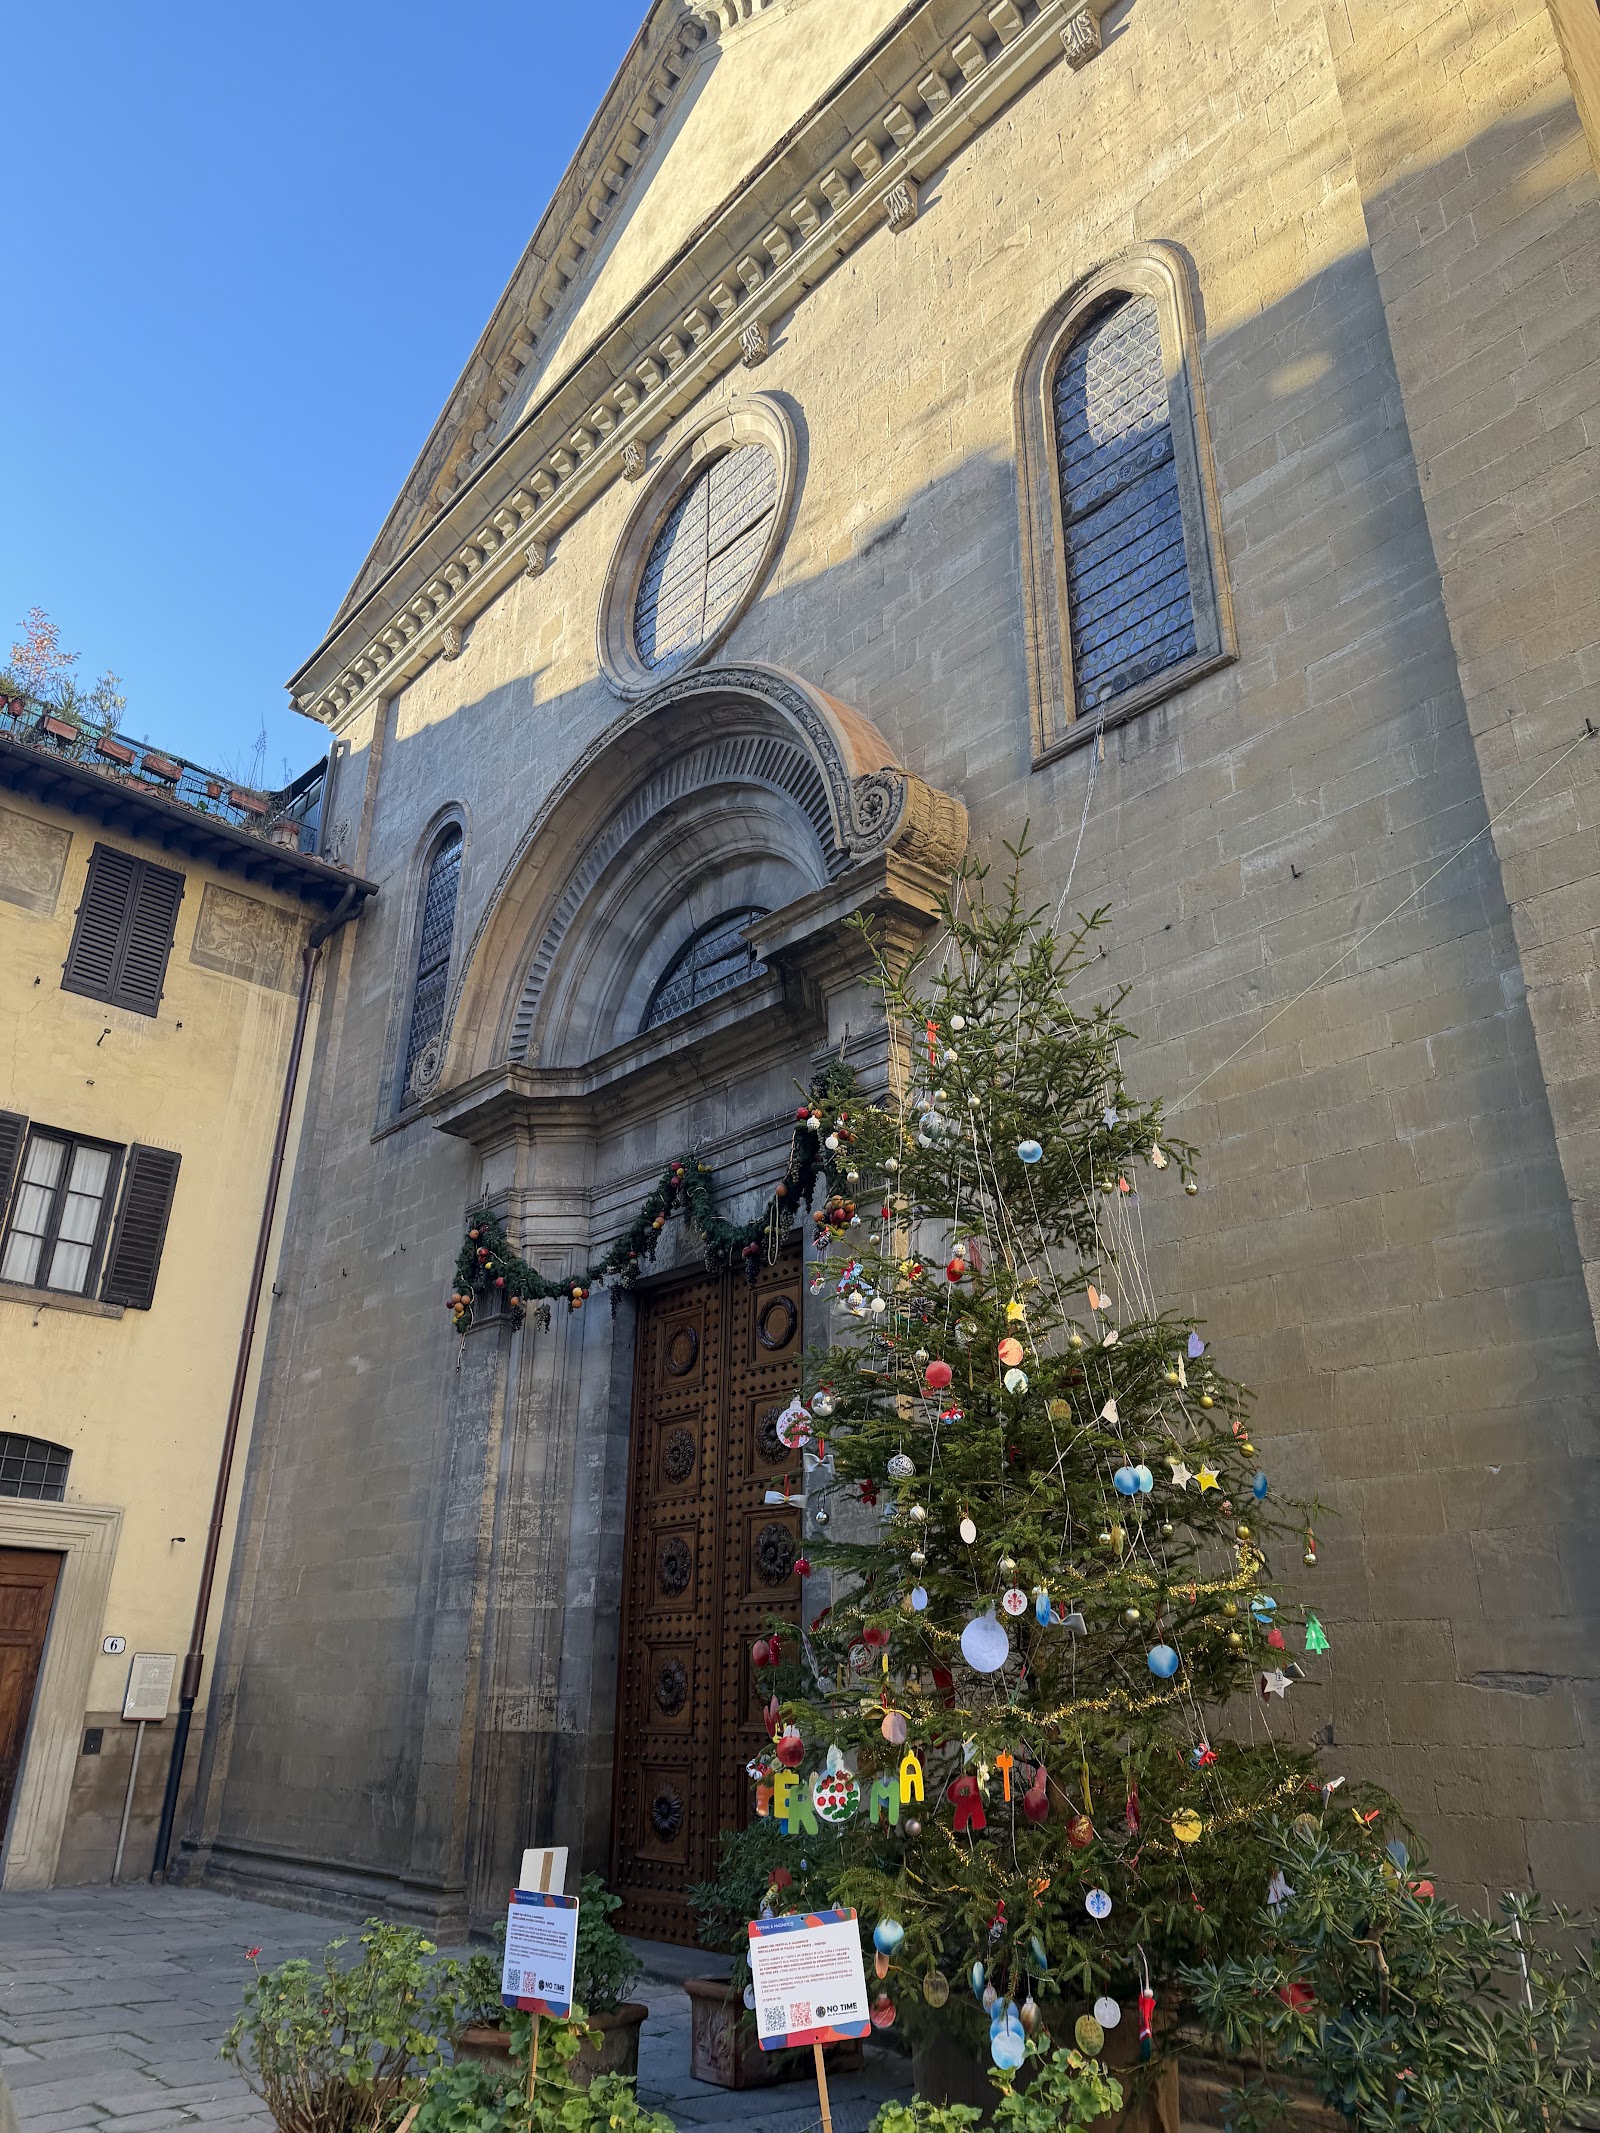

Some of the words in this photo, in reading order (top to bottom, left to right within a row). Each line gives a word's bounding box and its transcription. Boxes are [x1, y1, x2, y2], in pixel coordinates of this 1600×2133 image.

[110, 1639, 118, 1651] 6
[553, 1983, 565, 1991] TIME
[826, 2004, 839, 2013] NO
[840, 2002, 858, 2011] TIME
